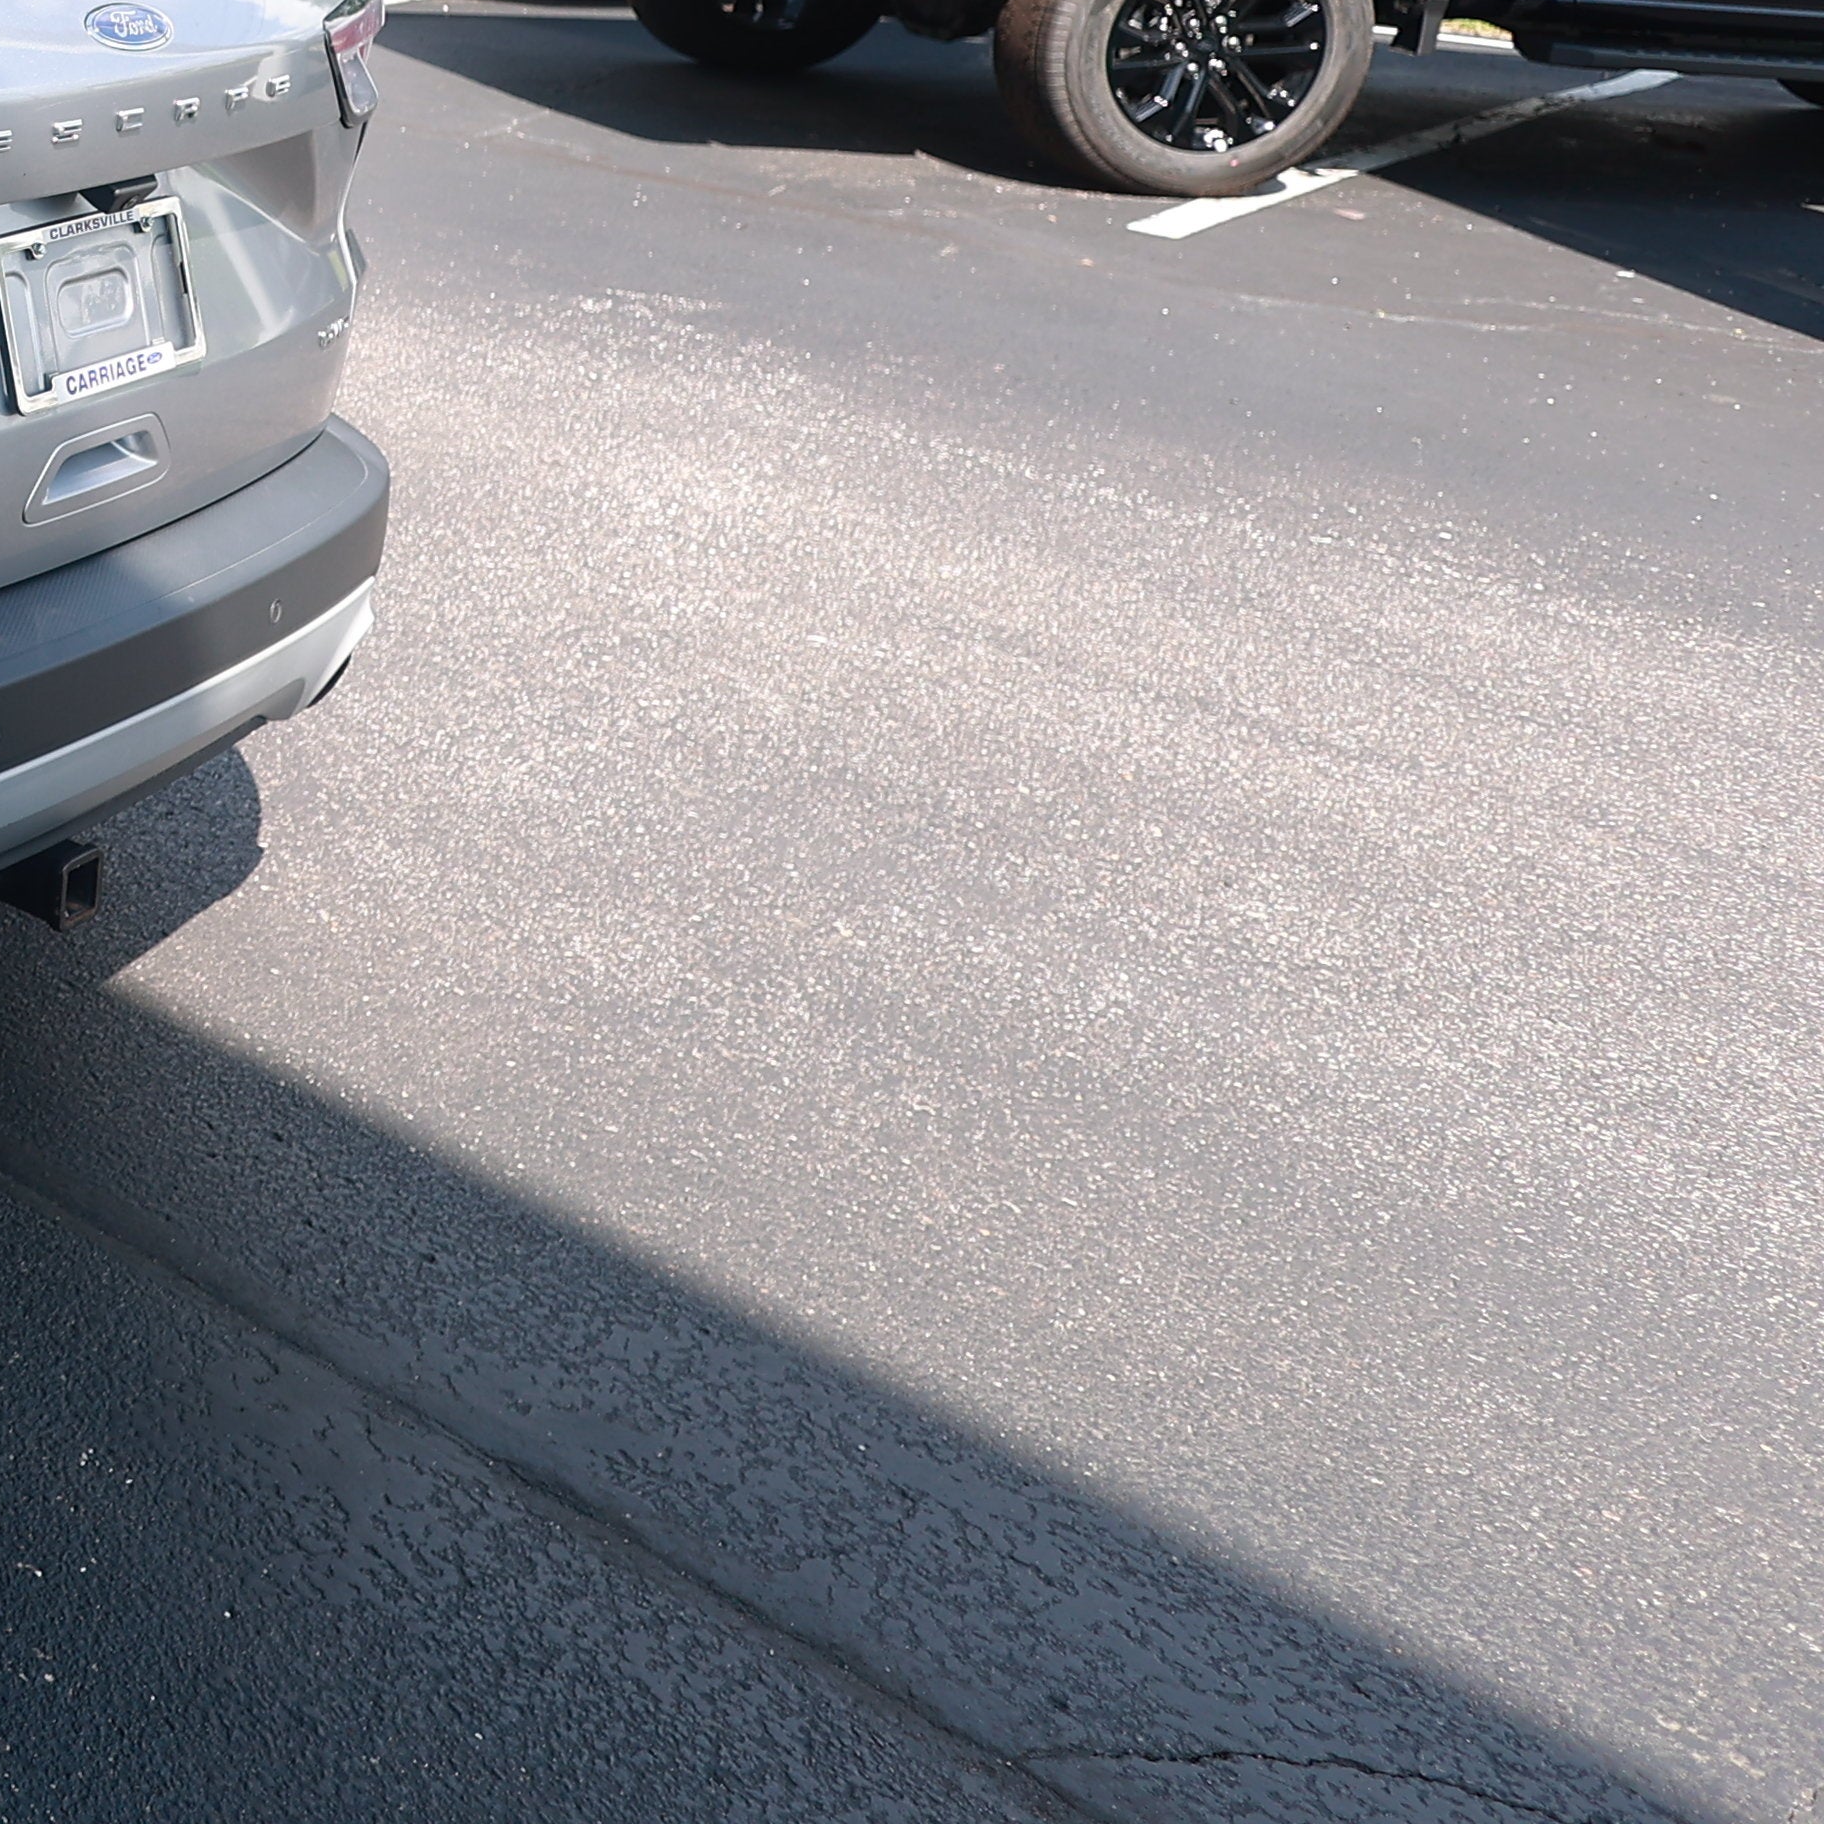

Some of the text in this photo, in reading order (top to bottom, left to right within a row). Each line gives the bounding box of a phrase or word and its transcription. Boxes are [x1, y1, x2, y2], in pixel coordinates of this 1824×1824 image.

[109, 9, 159, 39] Ford
[49, 209, 135, 241] CLARKSVILLE
[65, 352, 148, 396] CARRIAGE
